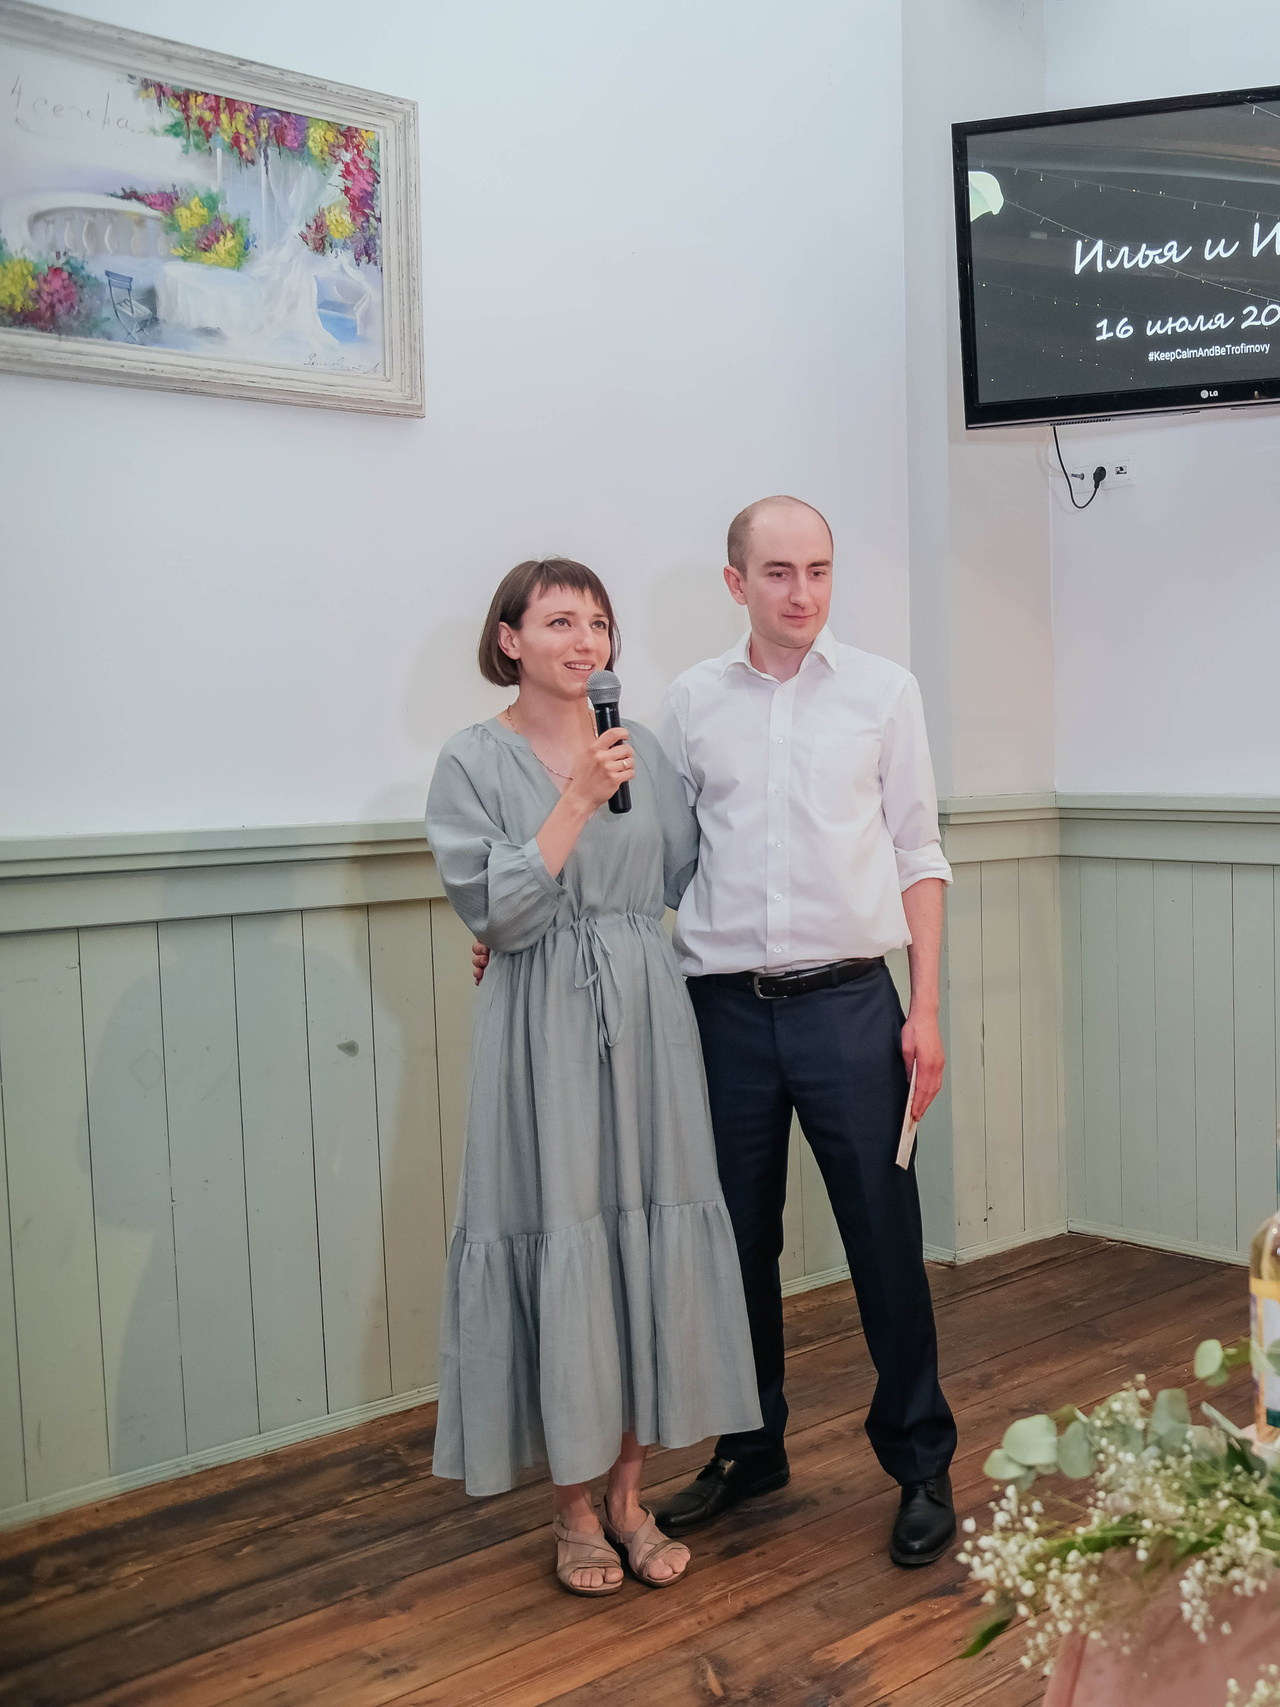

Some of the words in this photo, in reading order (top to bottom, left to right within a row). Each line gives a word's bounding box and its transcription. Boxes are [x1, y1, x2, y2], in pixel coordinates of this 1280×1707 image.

[1074, 239, 1192, 274] Илья
[1203, 238, 1239, 261] и
[1095, 317, 1134, 341] 16
[1146, 312, 1235, 336] июля
[1147, 342, 1270, 363] #KeepCalmAndBeTrofimovy
